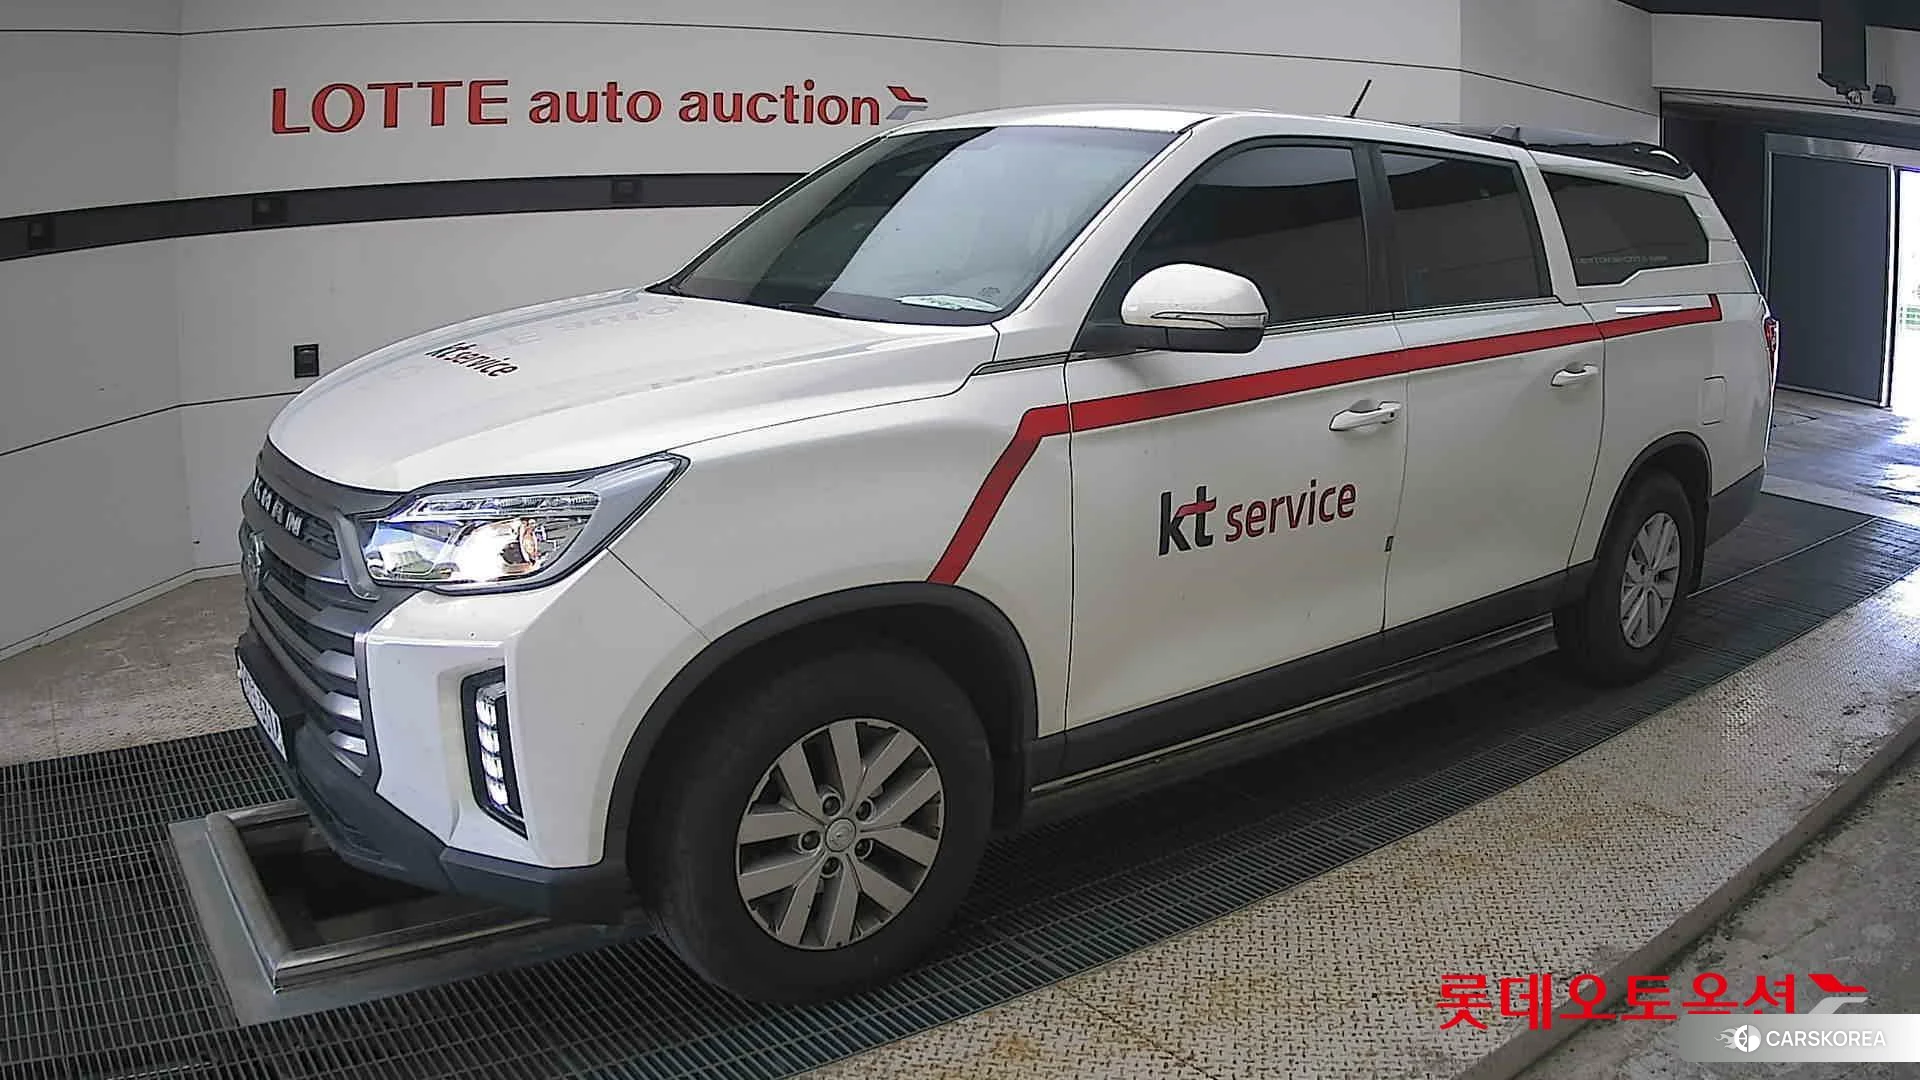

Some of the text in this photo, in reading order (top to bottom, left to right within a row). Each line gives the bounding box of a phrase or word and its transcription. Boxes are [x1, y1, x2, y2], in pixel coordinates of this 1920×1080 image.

[271, 79, 881, 135] LOTTE auto auction
[444, 352, 519, 377] service
[1158, 479, 1357, 556] kt service
